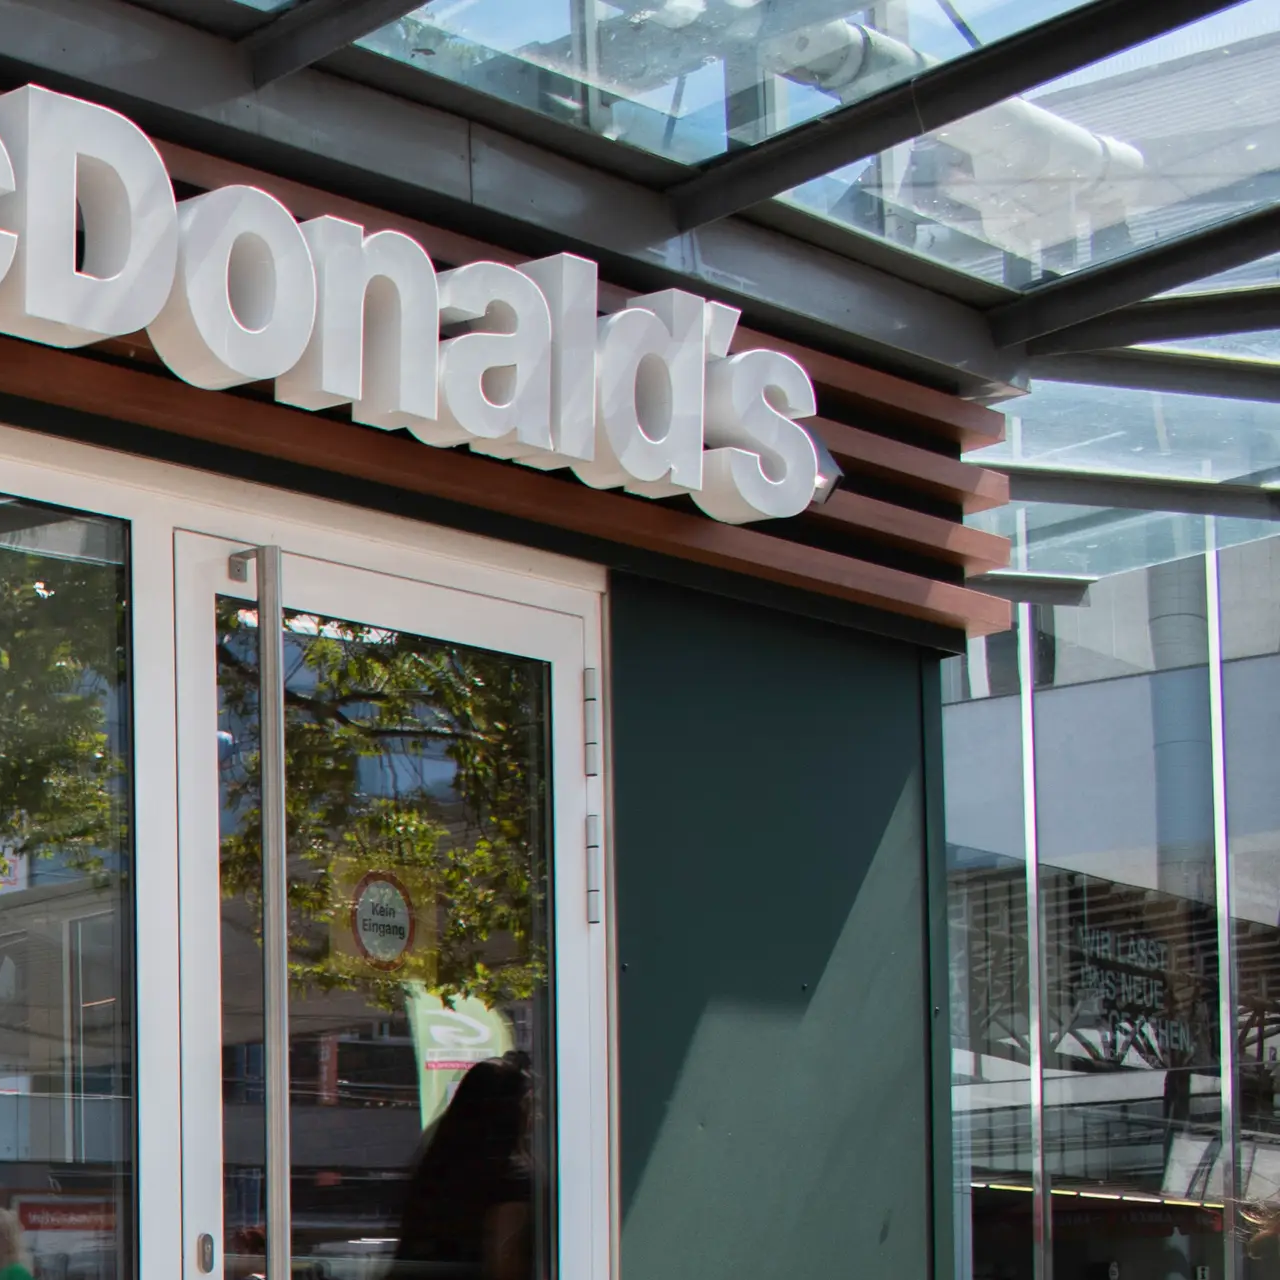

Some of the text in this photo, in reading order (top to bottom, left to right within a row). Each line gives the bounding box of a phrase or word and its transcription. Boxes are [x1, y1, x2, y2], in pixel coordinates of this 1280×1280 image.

[371, 902, 395, 918] Kein
[362, 919, 405, 940] Eingang
[1120, 972, 1165, 1009] NEUE
